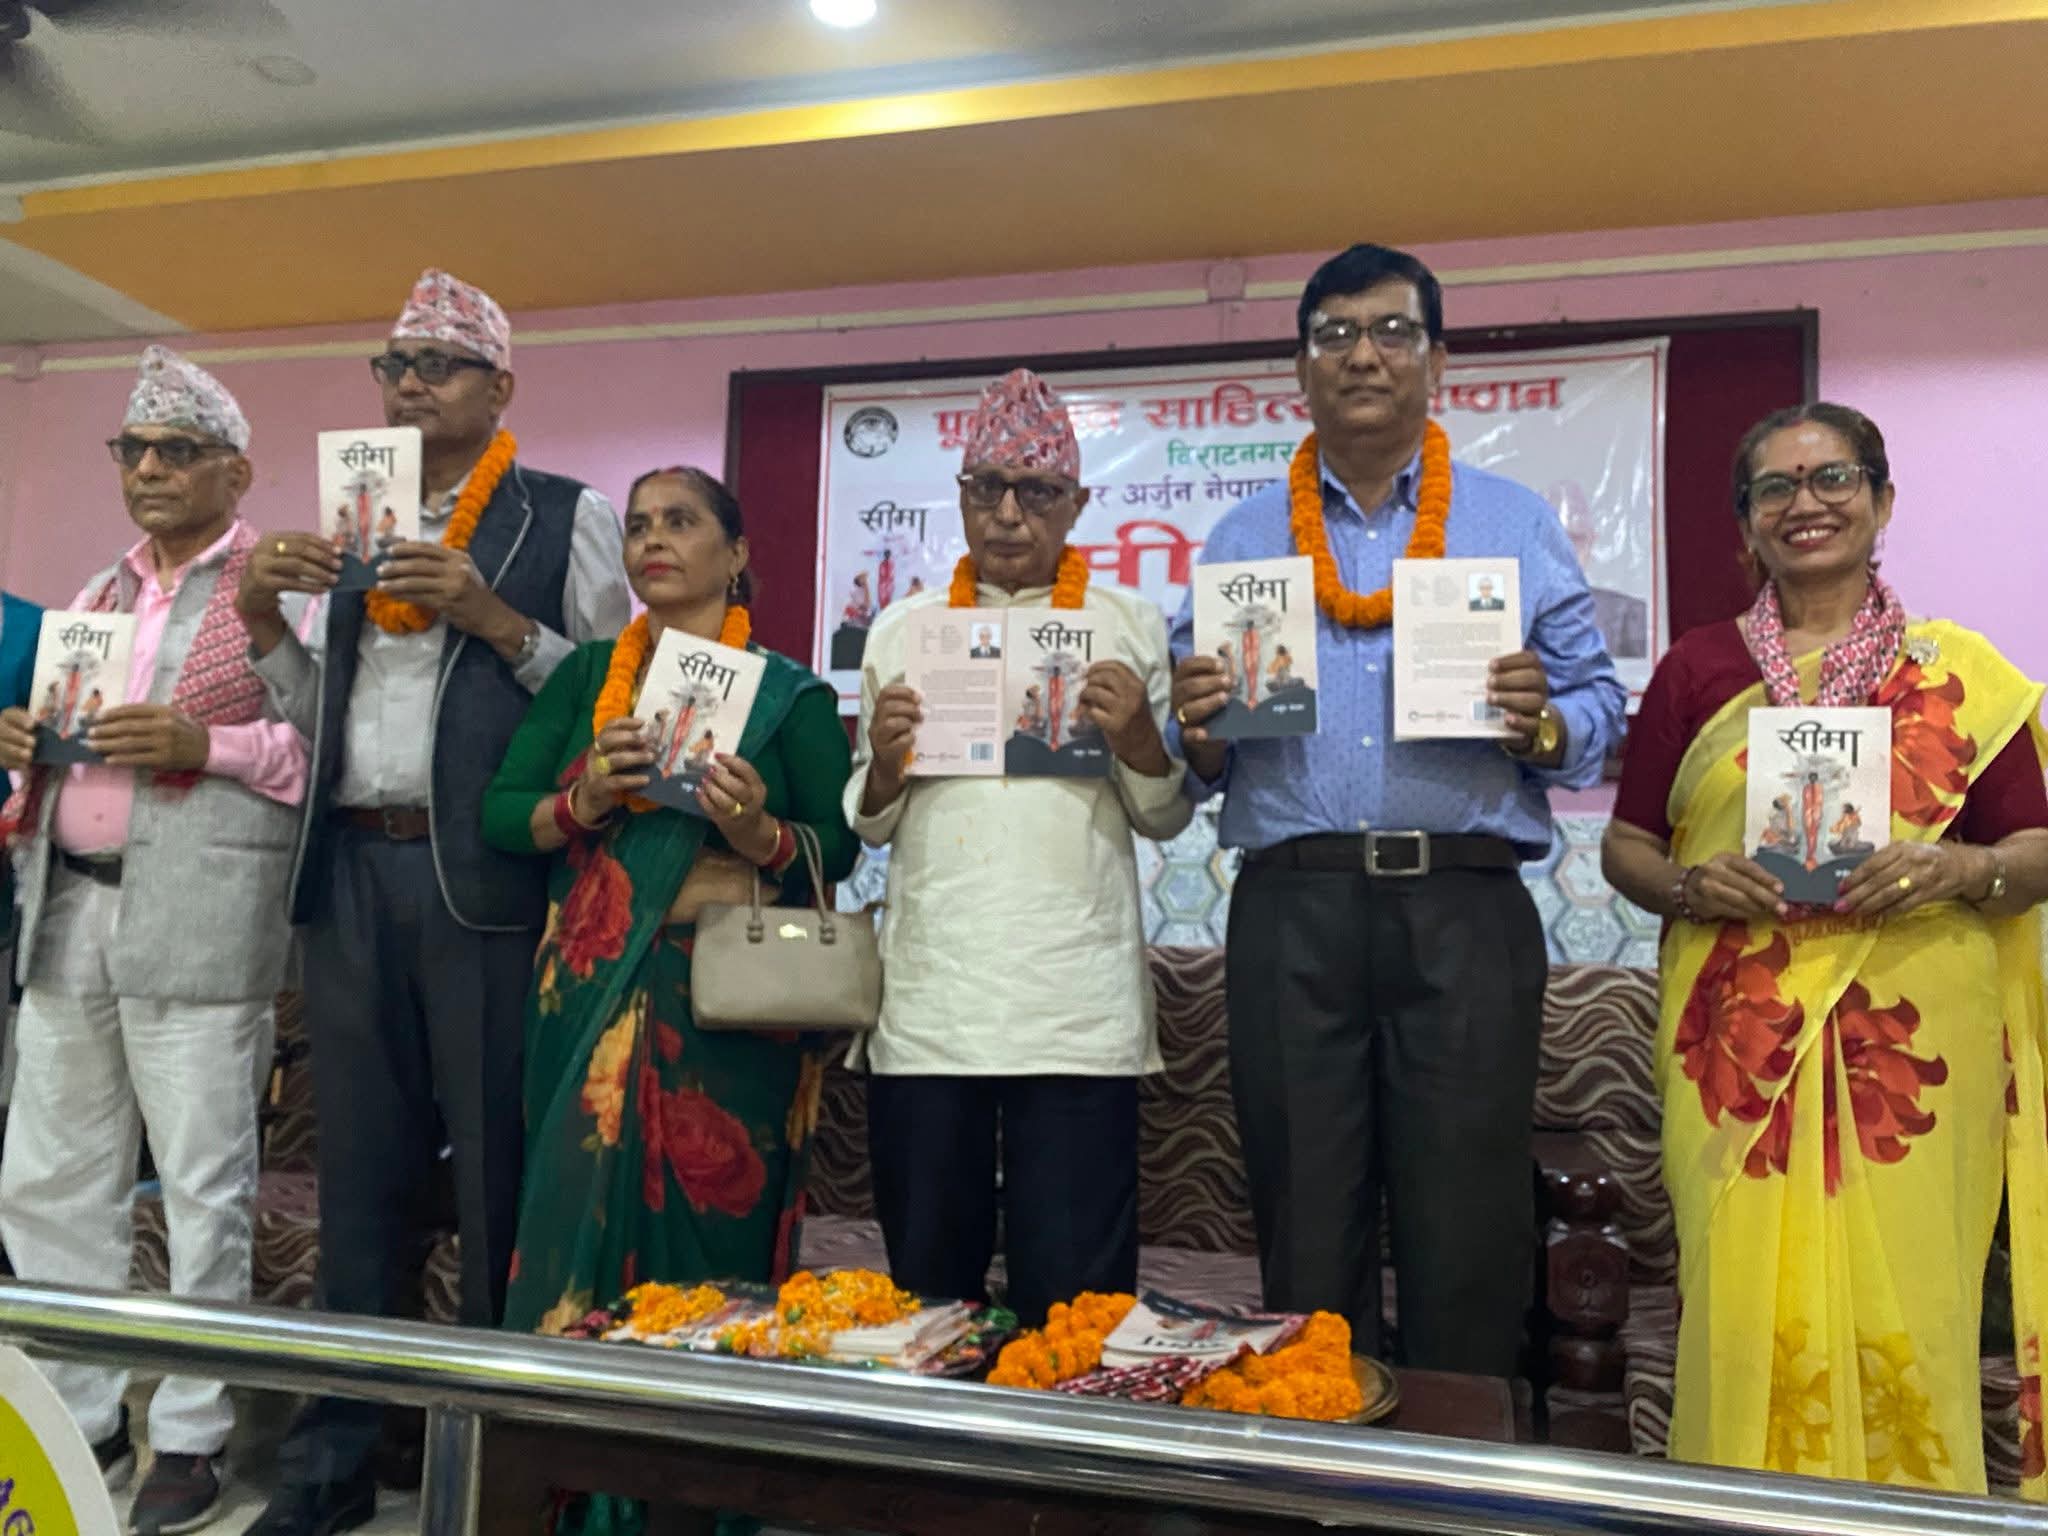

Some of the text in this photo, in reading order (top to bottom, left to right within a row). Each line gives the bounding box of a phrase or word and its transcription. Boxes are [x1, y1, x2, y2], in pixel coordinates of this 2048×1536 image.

[1430, 378, 1566, 414] ष्ठान
[338, 441, 396, 477] सीमा
[1123, 475, 1194, 510] अर्जुन
[859, 500, 928, 542] सीमा
[1218, 573, 1290, 612] सीमा
[58, 622, 114, 660] सीमा
[1030, 621, 1094, 662] सीमा
[678, 651, 740, 701] सीमा
[1777, 720, 1863, 767] सीमा
